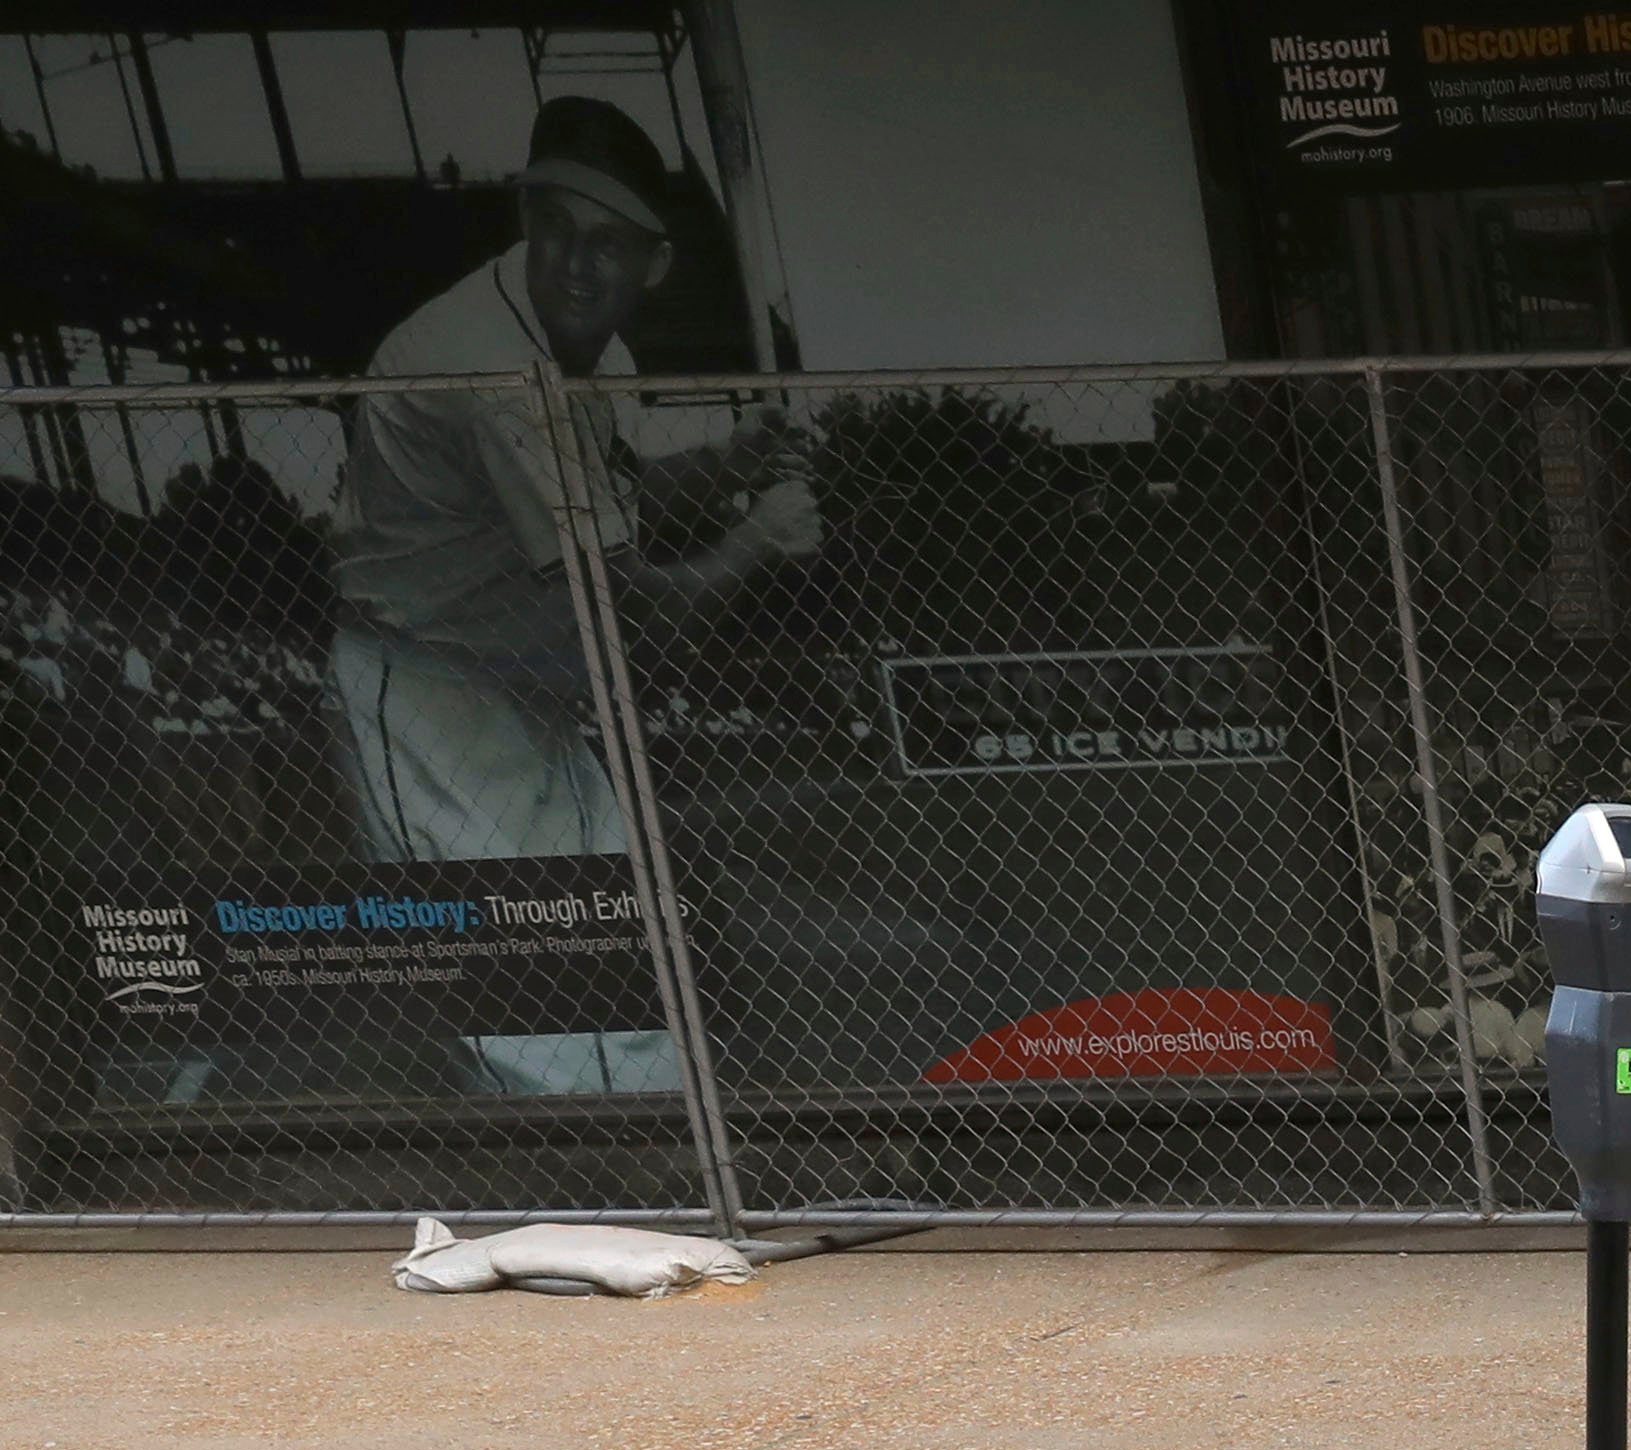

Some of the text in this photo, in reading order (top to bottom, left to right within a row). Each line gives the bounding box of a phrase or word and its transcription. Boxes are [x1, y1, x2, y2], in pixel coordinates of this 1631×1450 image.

[1269, 30, 1392, 63] Missouri
[1422, 22, 1574, 63] Discover
[1282, 65, 1386, 93] History
[1429, 74, 1515, 99] Washington
[1519, 72, 1572, 93] Avenue
[1575, 71, 1610, 90] west
[1279, 95, 1398, 122] Museum
[1482, 100, 1544, 125] Missouri
[1547, 97, 1598, 121] History
[1301, 146, 1394, 164] mohistory.org
[1051, 730, 1122, 757] ICE
[82, 903, 189, 929] Missouri
[215, 898, 347, 934] Discover
[355, 895, 480, 933] History:
[484, 892, 588, 929] Through
[97, 931, 188, 957] History
[225, 945, 255, 964] Stan
[319, 942, 364, 964] batting
[366, 941, 410, 960] stance
[411, 940, 427, 957] at
[428, 937, 509, 960] Sportsman's
[546, 933, 632, 956] Photographer
[95, 957, 202, 980] Museum
[302, 968, 358, 985] Missouri
[360, 966, 405, 986] History
[120, 1001, 199, 1015] mohistory.org
[1018, 1026, 1316, 1060] www.explorestlouis.com
